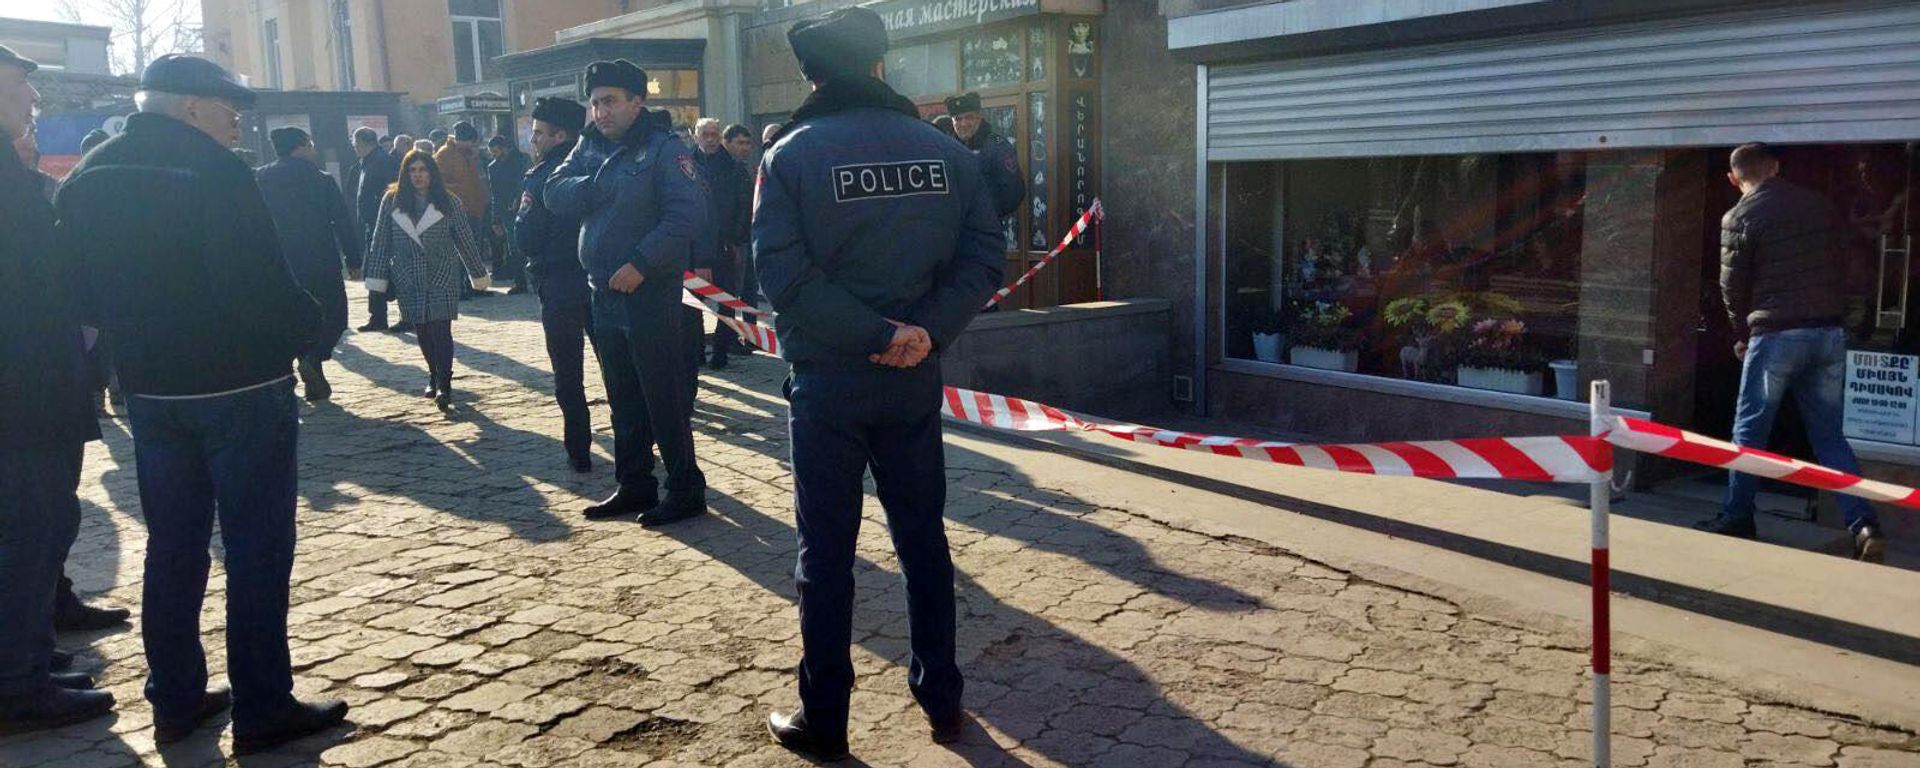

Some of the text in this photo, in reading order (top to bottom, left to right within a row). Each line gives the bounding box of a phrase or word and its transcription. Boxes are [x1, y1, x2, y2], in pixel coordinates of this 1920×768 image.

[880, 0, 1036, 31] ная мастерск
[839, 164, 944, 195] POLICE
[1856, 368, 1908, 383] ՄԻԱՅՆ
[1850, 382, 1913, 398] ԴԻՄԱԿՈՎ
